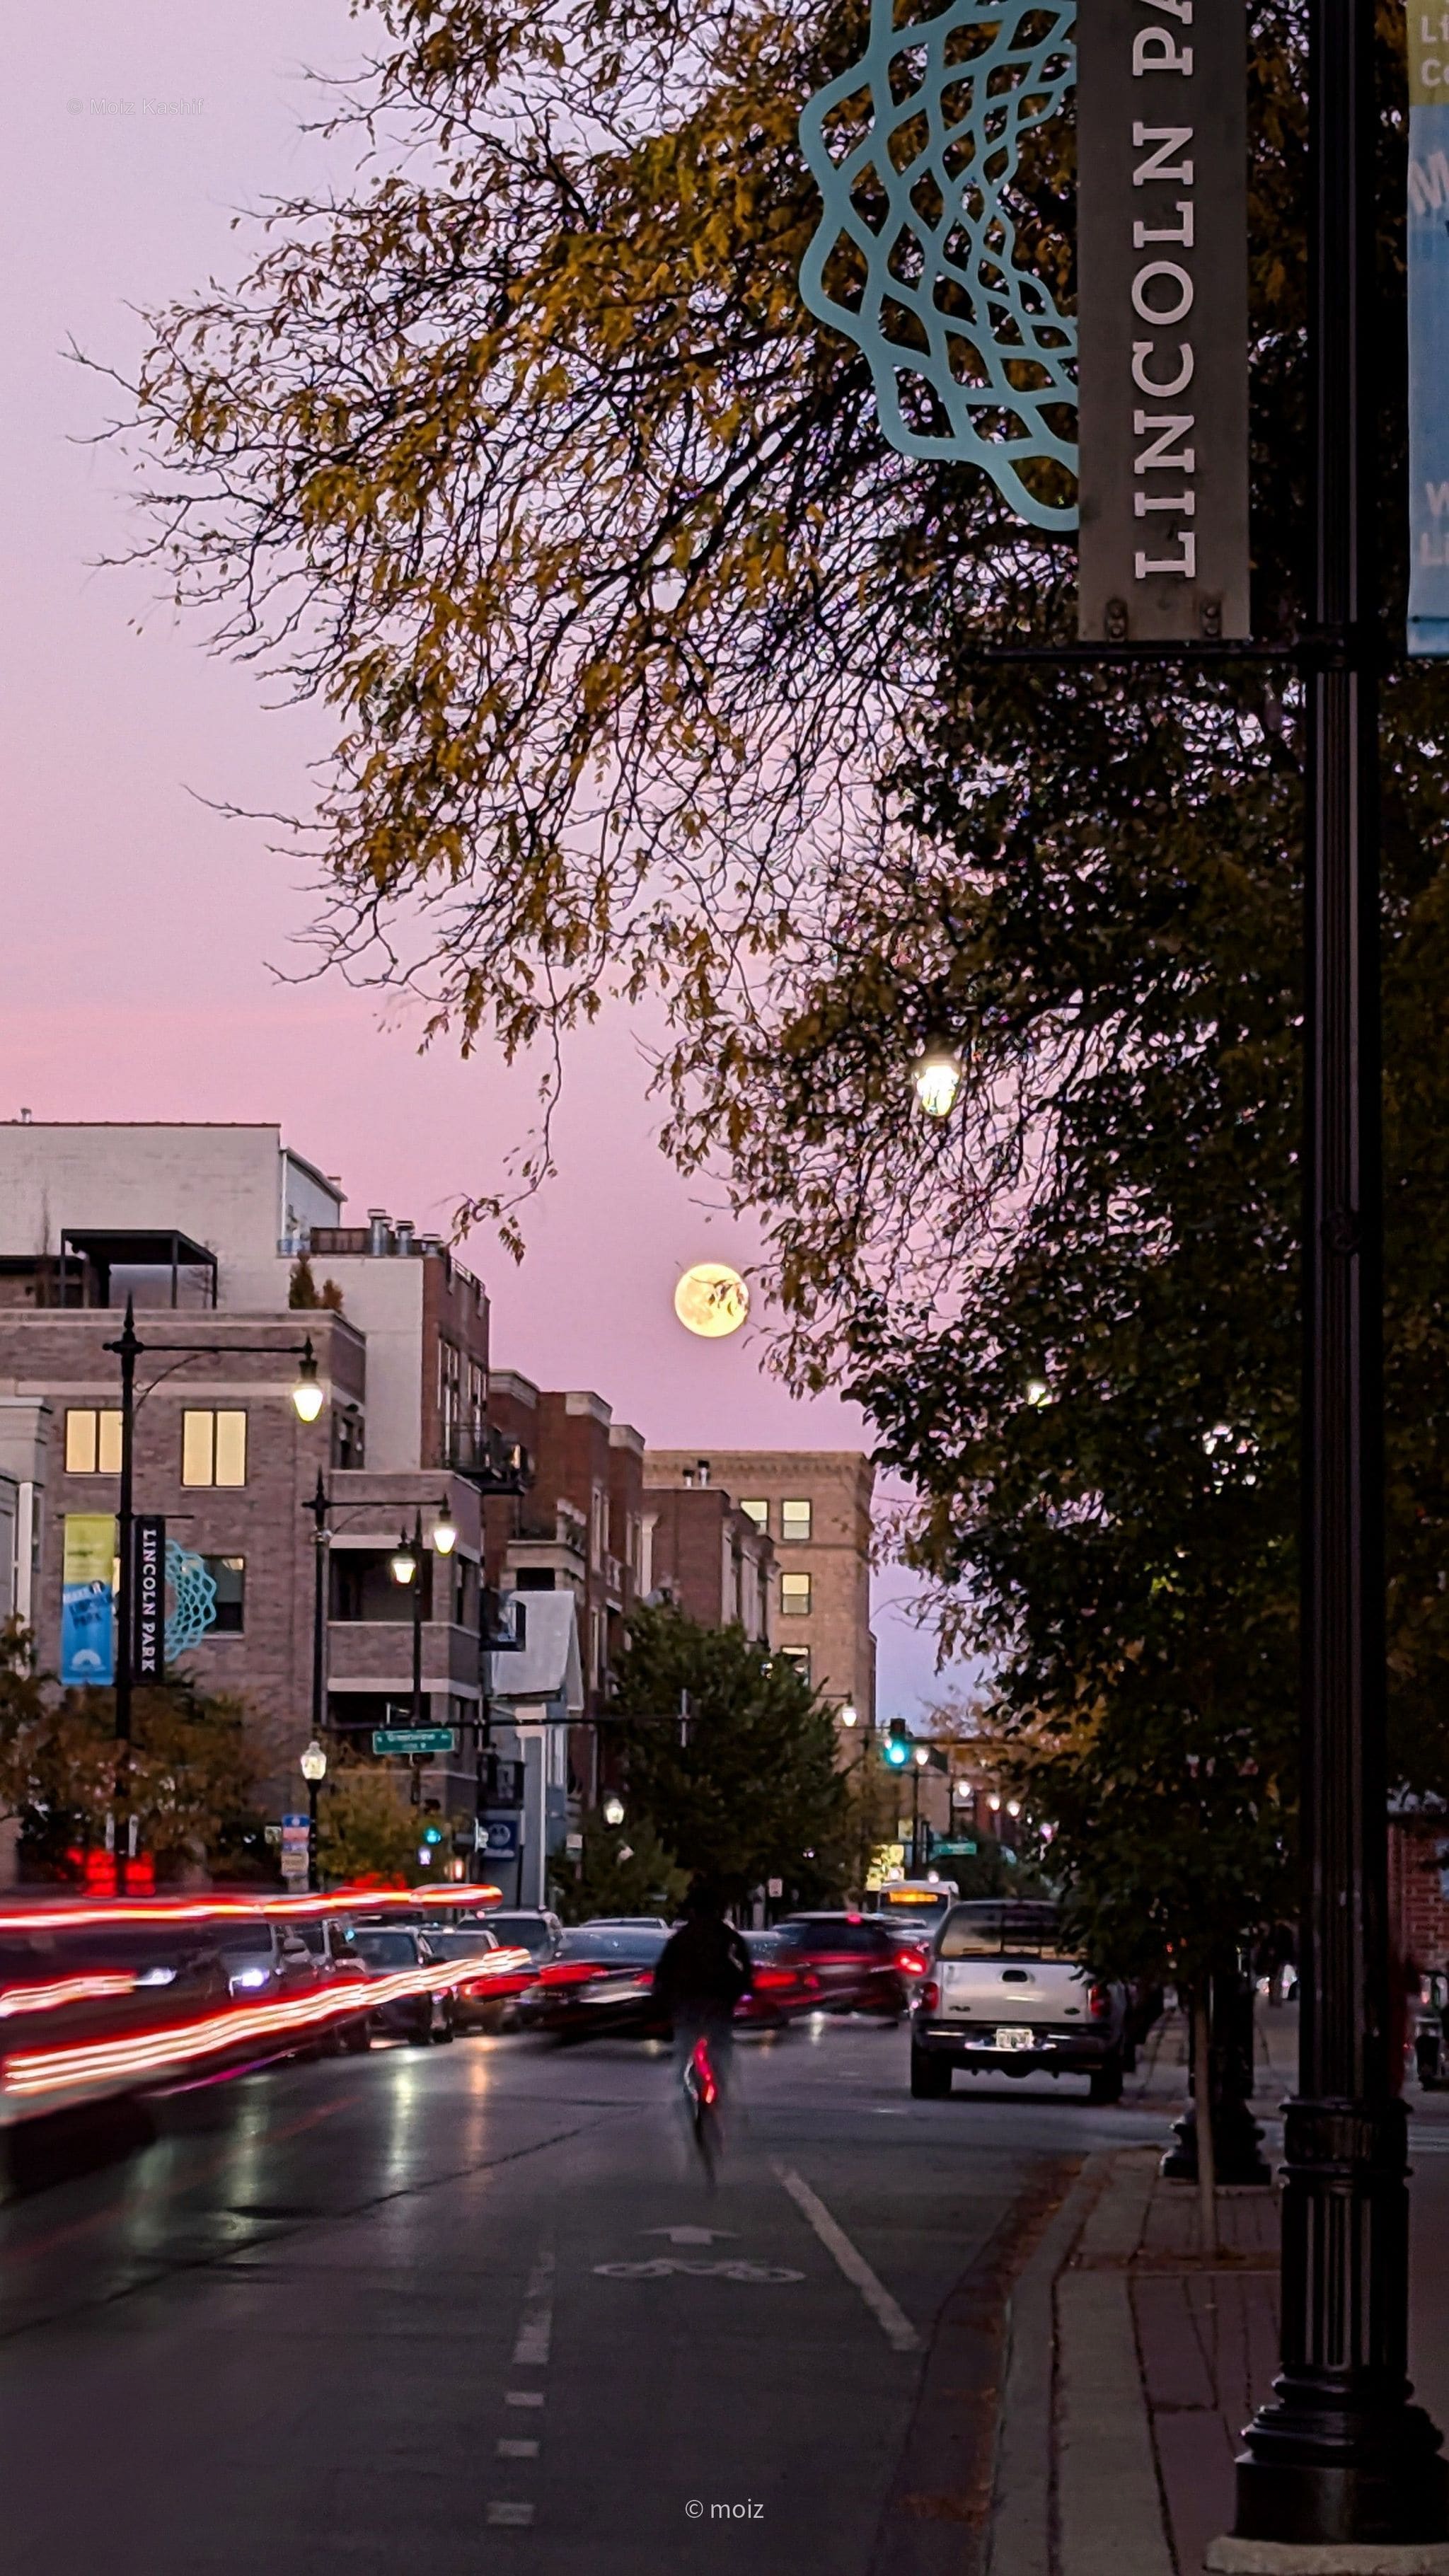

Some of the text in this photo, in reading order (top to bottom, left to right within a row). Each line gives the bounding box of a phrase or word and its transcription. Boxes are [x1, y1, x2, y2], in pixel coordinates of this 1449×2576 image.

[1421, 57, 1449, 86] C
[1132, 121, 1196, 579] LINCOLN
[142, 1530, 156, 1672] LINCOLN PARK
